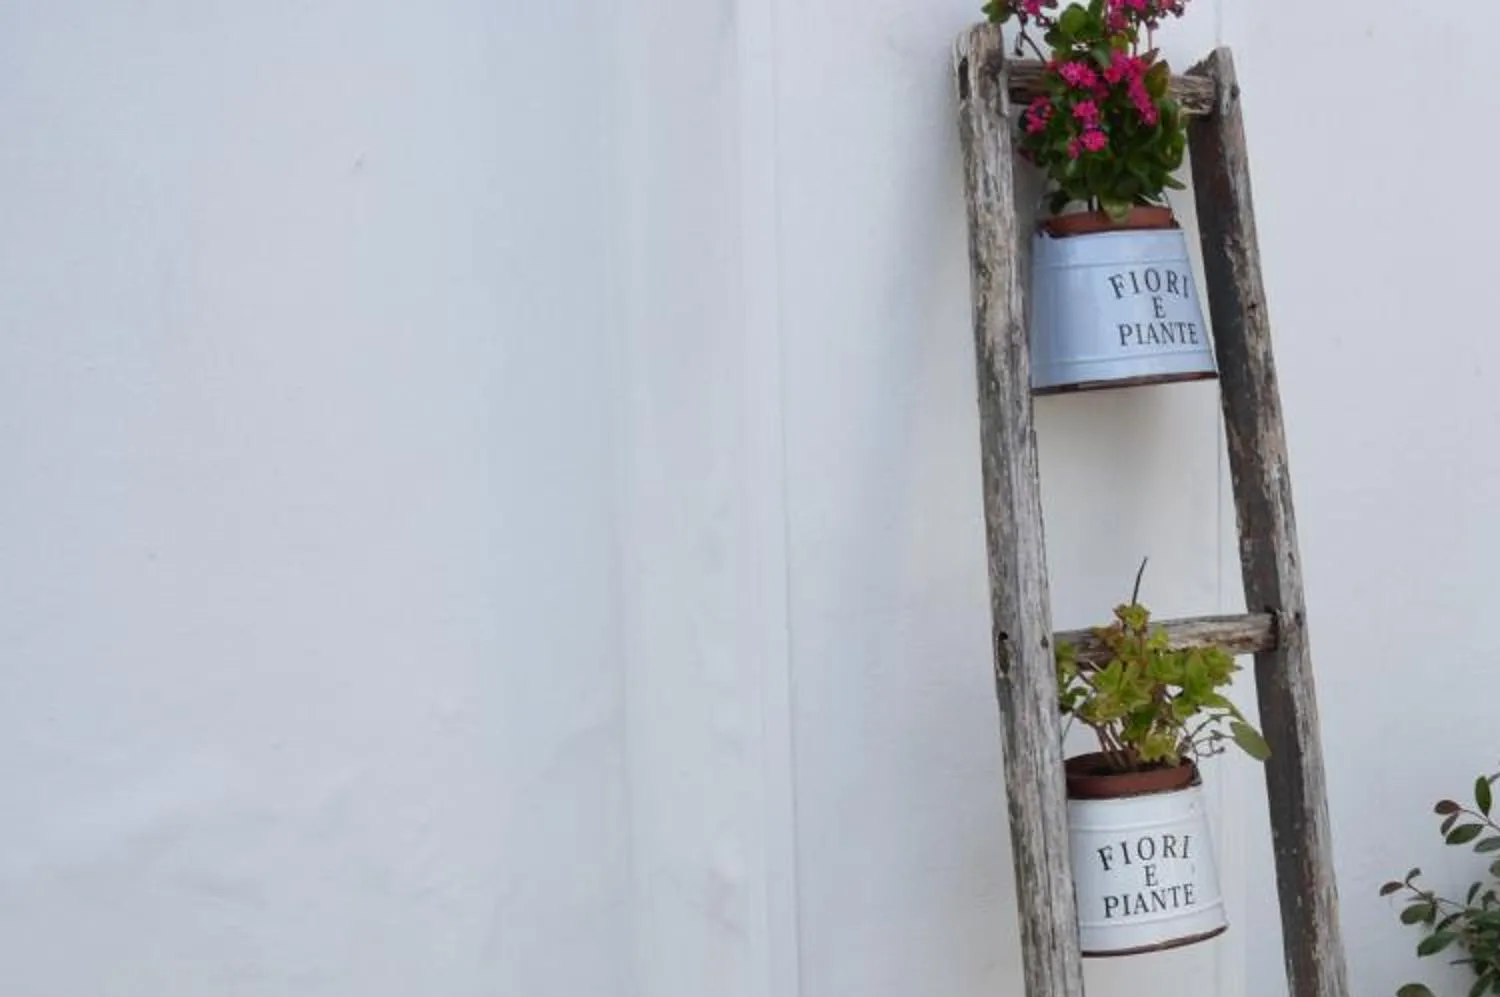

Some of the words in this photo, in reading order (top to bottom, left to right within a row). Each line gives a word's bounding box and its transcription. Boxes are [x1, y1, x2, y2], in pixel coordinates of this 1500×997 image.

[1108, 267, 1189, 300] FIORI
[1153, 296, 1167, 319] E
[1118, 322, 1199, 346] PIANTE
[1097, 834, 1192, 871] FIORI
[1143, 864, 1158, 887] E
[1103, 883, 1196, 918] PIANTE
